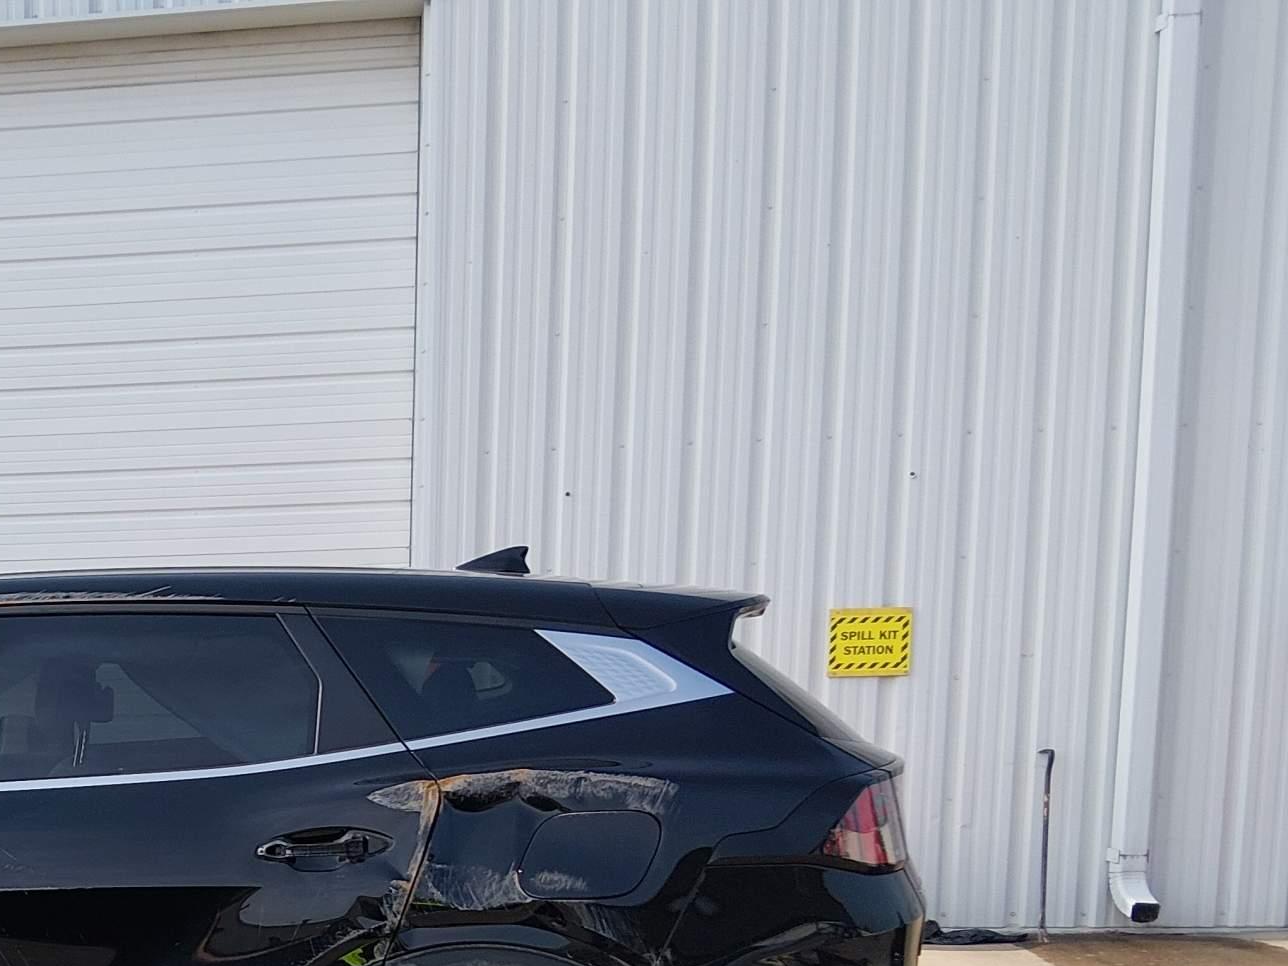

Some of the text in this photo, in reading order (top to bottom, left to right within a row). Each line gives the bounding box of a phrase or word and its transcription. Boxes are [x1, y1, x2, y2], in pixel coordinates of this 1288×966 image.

[840, 630, 899, 641] SPILL KIT
[843, 645, 894, 655] STATION
